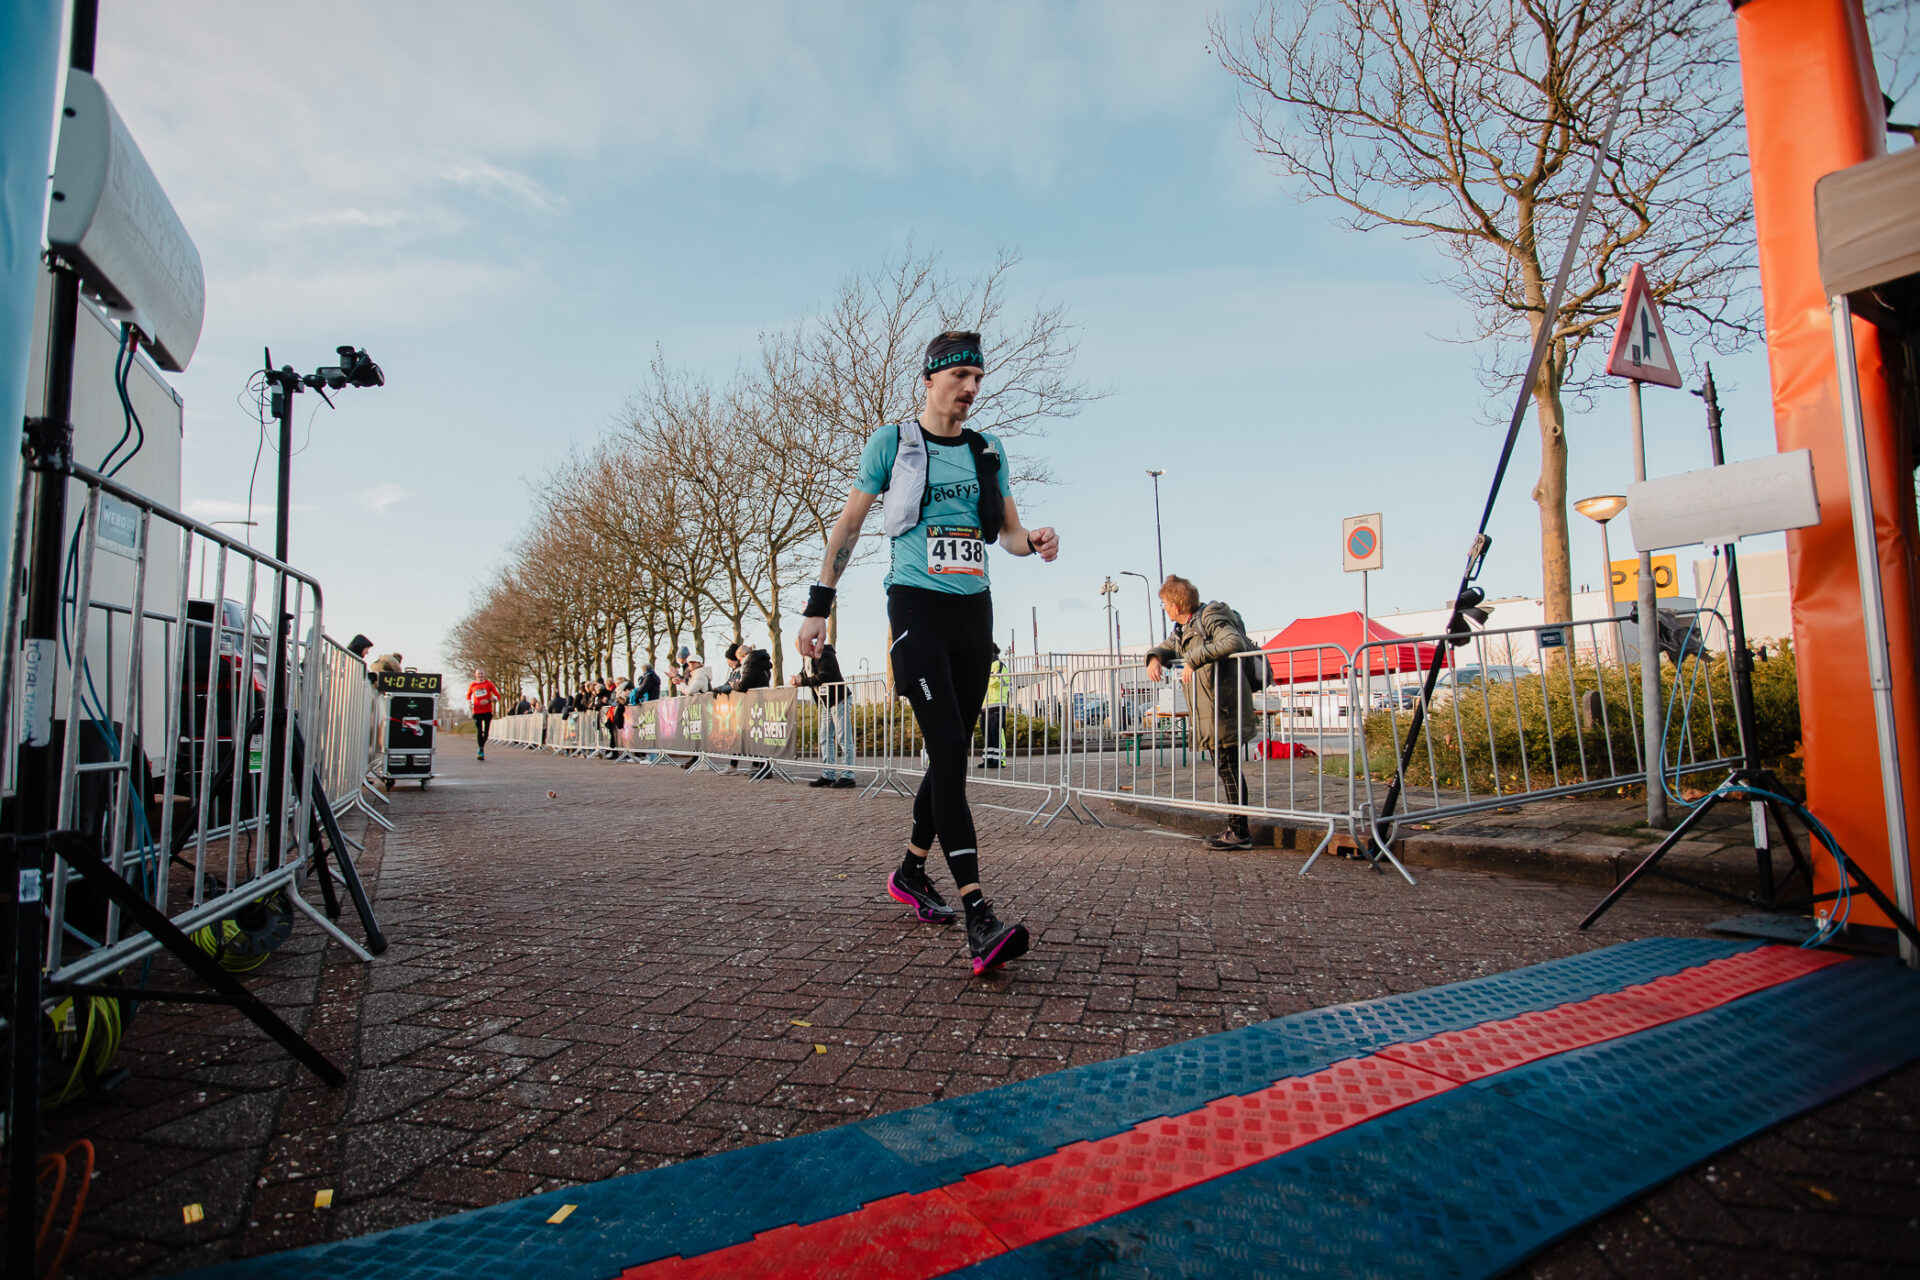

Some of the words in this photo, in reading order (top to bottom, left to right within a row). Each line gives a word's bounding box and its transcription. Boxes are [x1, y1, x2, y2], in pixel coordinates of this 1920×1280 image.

[932, 539, 982, 563] 4138
[1610, 565, 1673, 588] P0
[384, 676, 437, 689] 4:01:20
[919, 677, 932, 700] FUSION
[764, 701, 787, 721] VALK
[764, 721, 787, 739] EVENT
